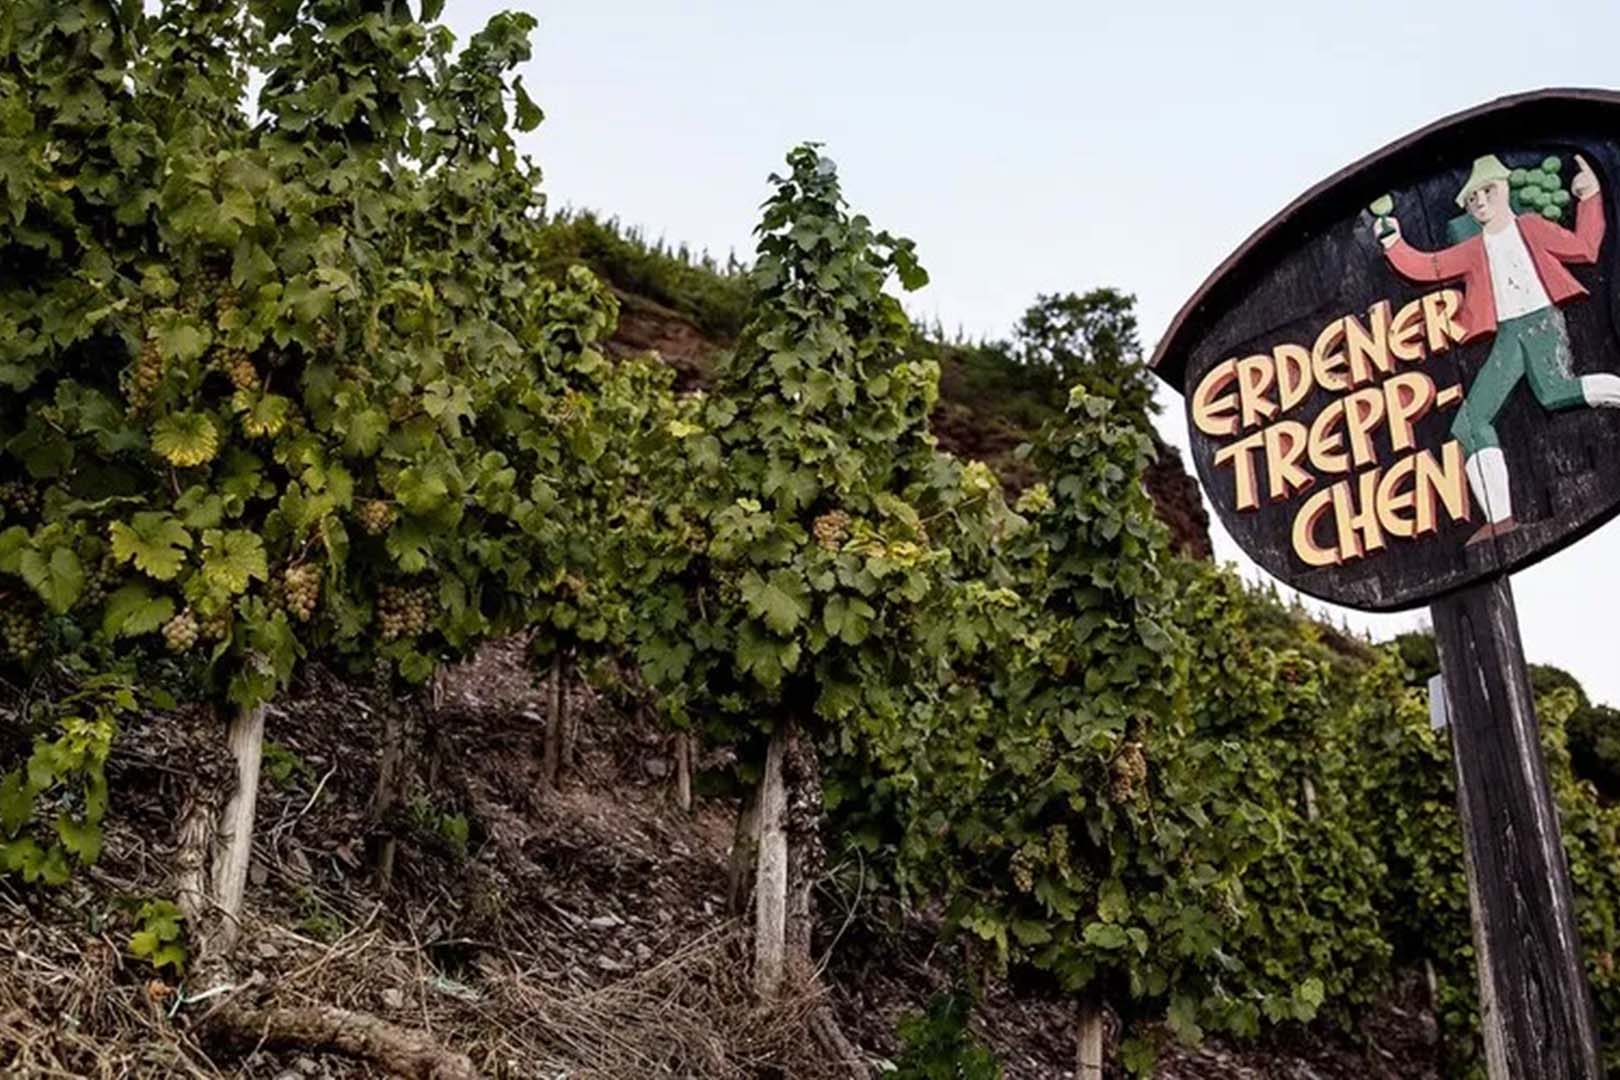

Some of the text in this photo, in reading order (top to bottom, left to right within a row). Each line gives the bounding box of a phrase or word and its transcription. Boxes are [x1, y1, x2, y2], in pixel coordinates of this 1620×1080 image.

[1192, 289, 1468, 435] ERDENER
[1213, 371, 1463, 511] TREPP-
[1292, 439, 1470, 566] CHEN
